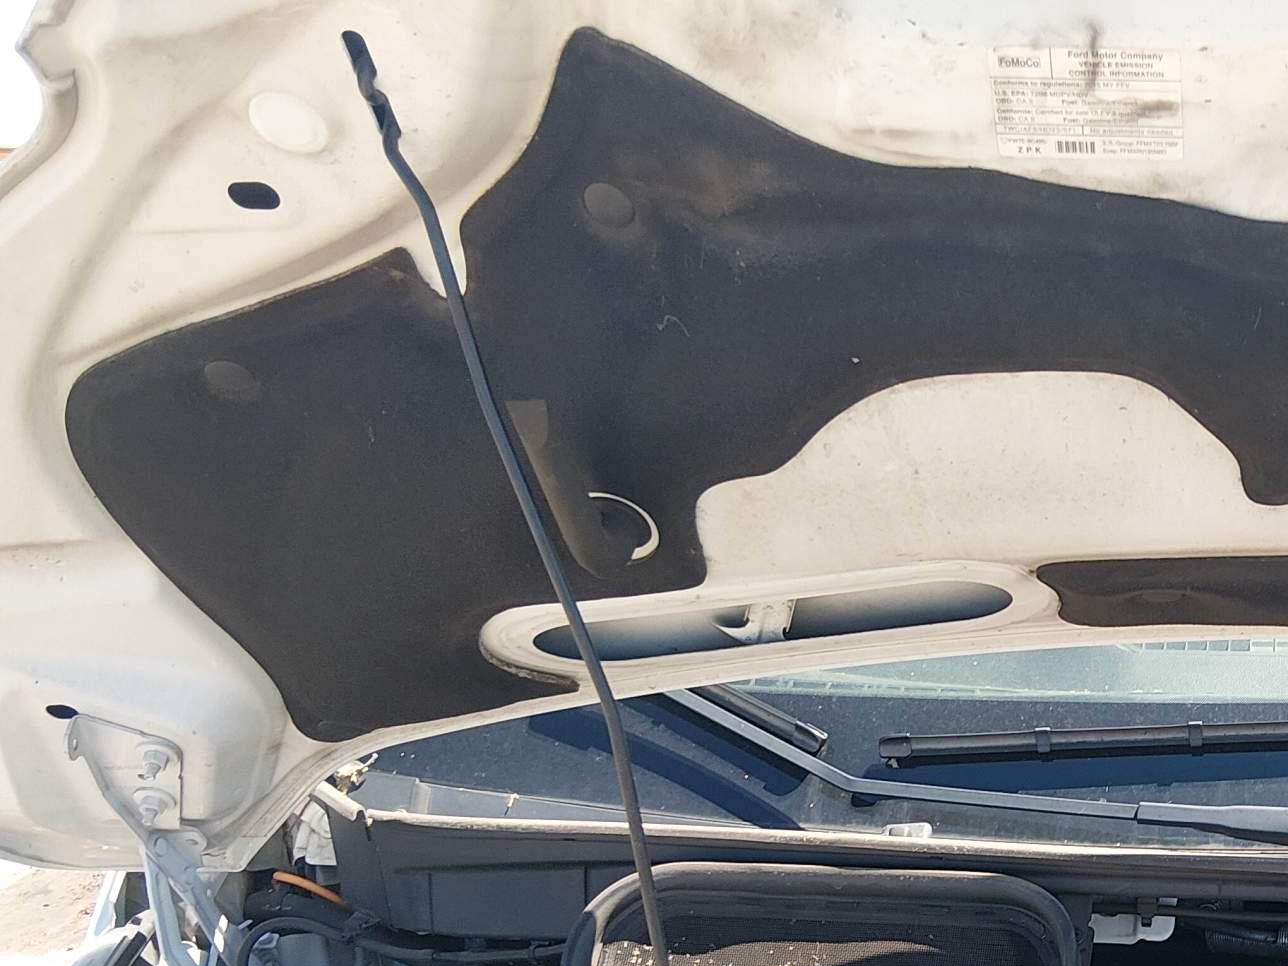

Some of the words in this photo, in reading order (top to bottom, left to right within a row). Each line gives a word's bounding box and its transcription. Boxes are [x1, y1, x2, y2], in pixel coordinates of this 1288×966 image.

[1067, 50, 1088, 59] Ford
[1091, 50, 1117, 60] Motor
[1120, 51, 1163, 61] Company
[998, 56, 1040, 68] FoMoCo
[1079, 61, 1112, 69] VEHICLE
[1069, 69, 1105, 77] CONTROL
